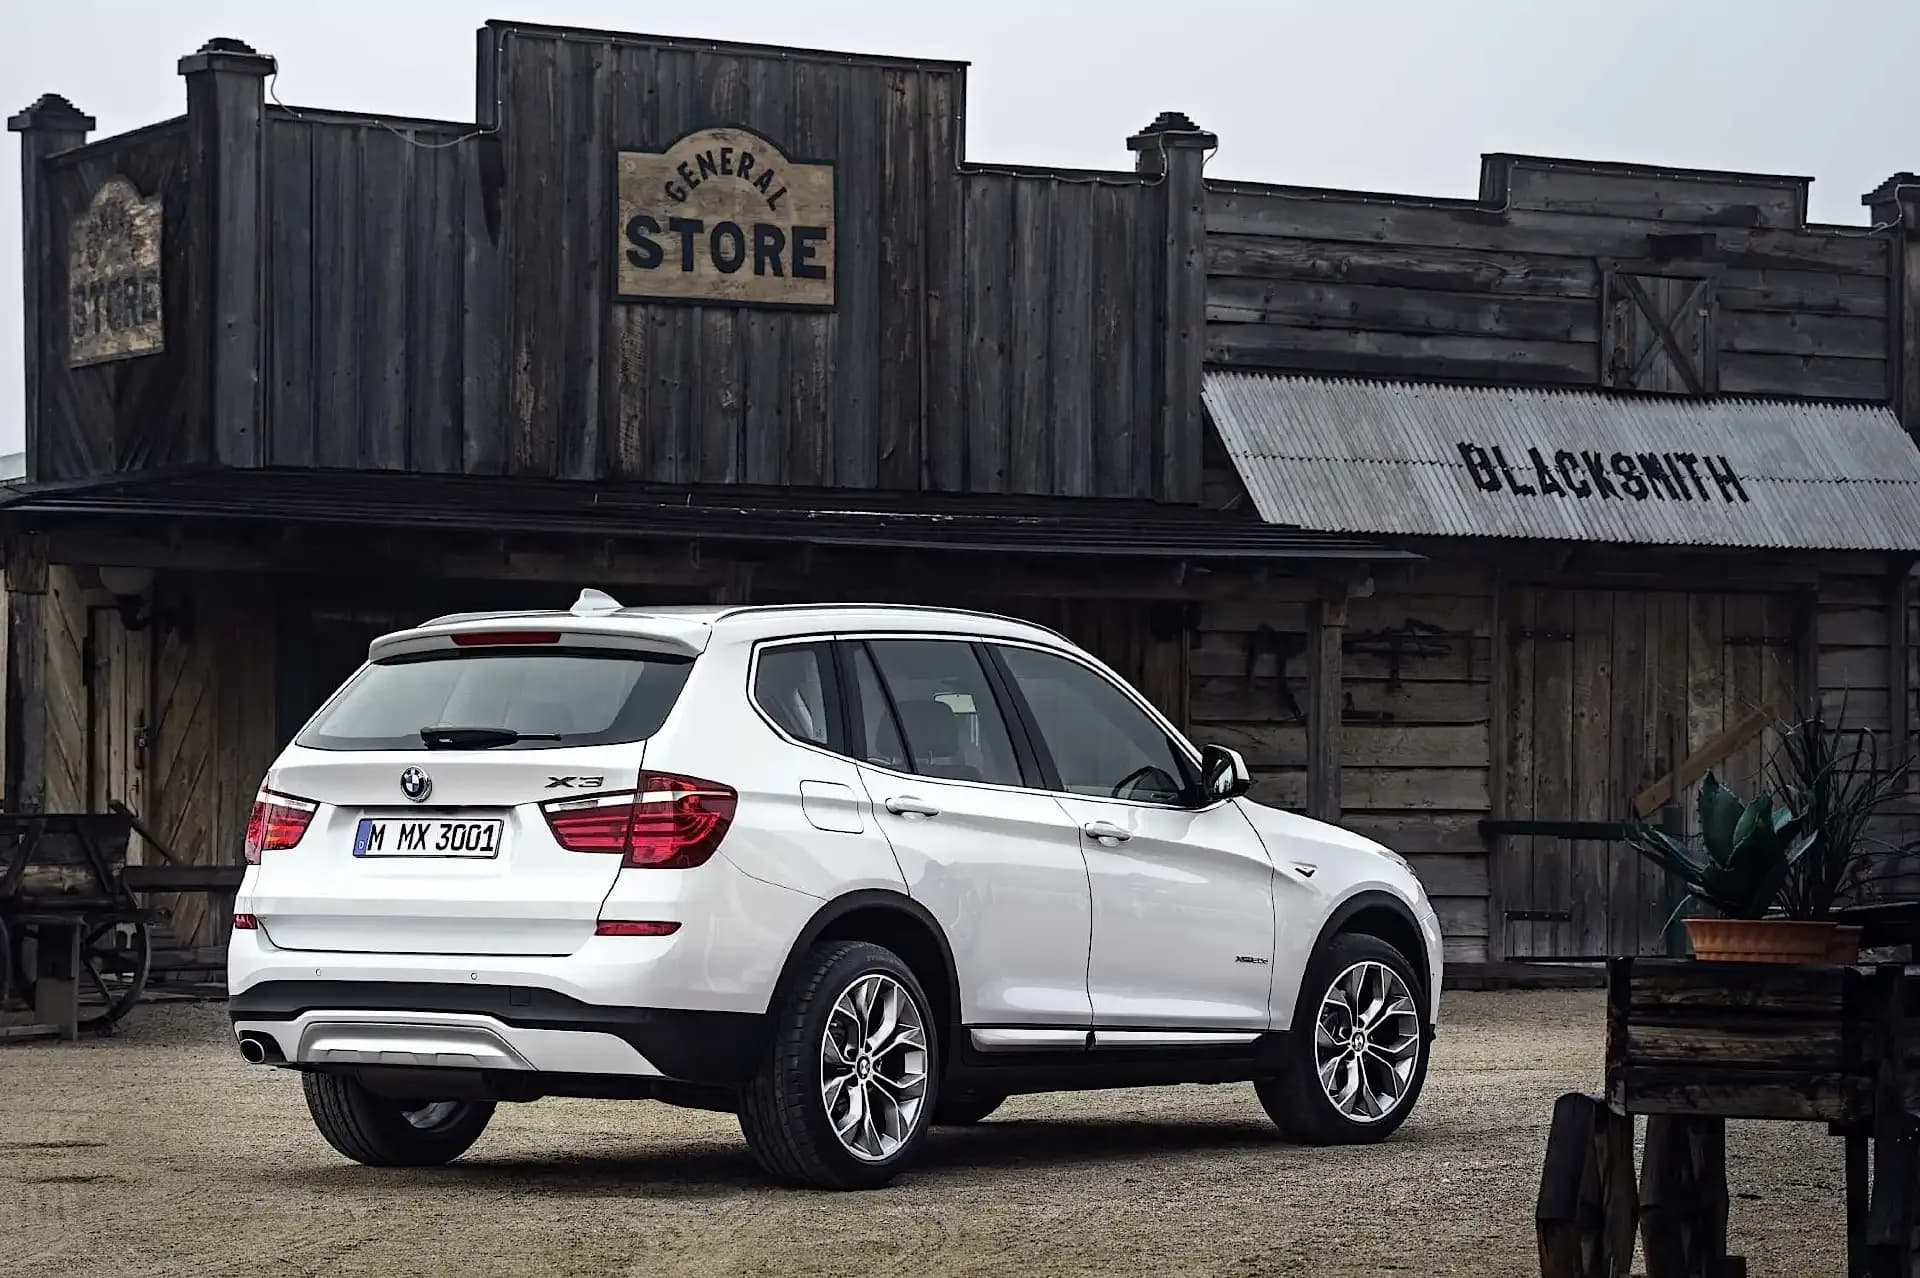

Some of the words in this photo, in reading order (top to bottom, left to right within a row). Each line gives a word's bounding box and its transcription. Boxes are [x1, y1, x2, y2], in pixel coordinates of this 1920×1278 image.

[665, 147, 788, 211] GENERAL
[626, 215, 827, 280] STORE
[1457, 442, 1750, 502] BLACKSMITH
[544, 776, 604, 788] X3
[367, 824, 386, 851] M
[397, 824, 431, 850] MX
[436, 824, 494, 852] 3001
